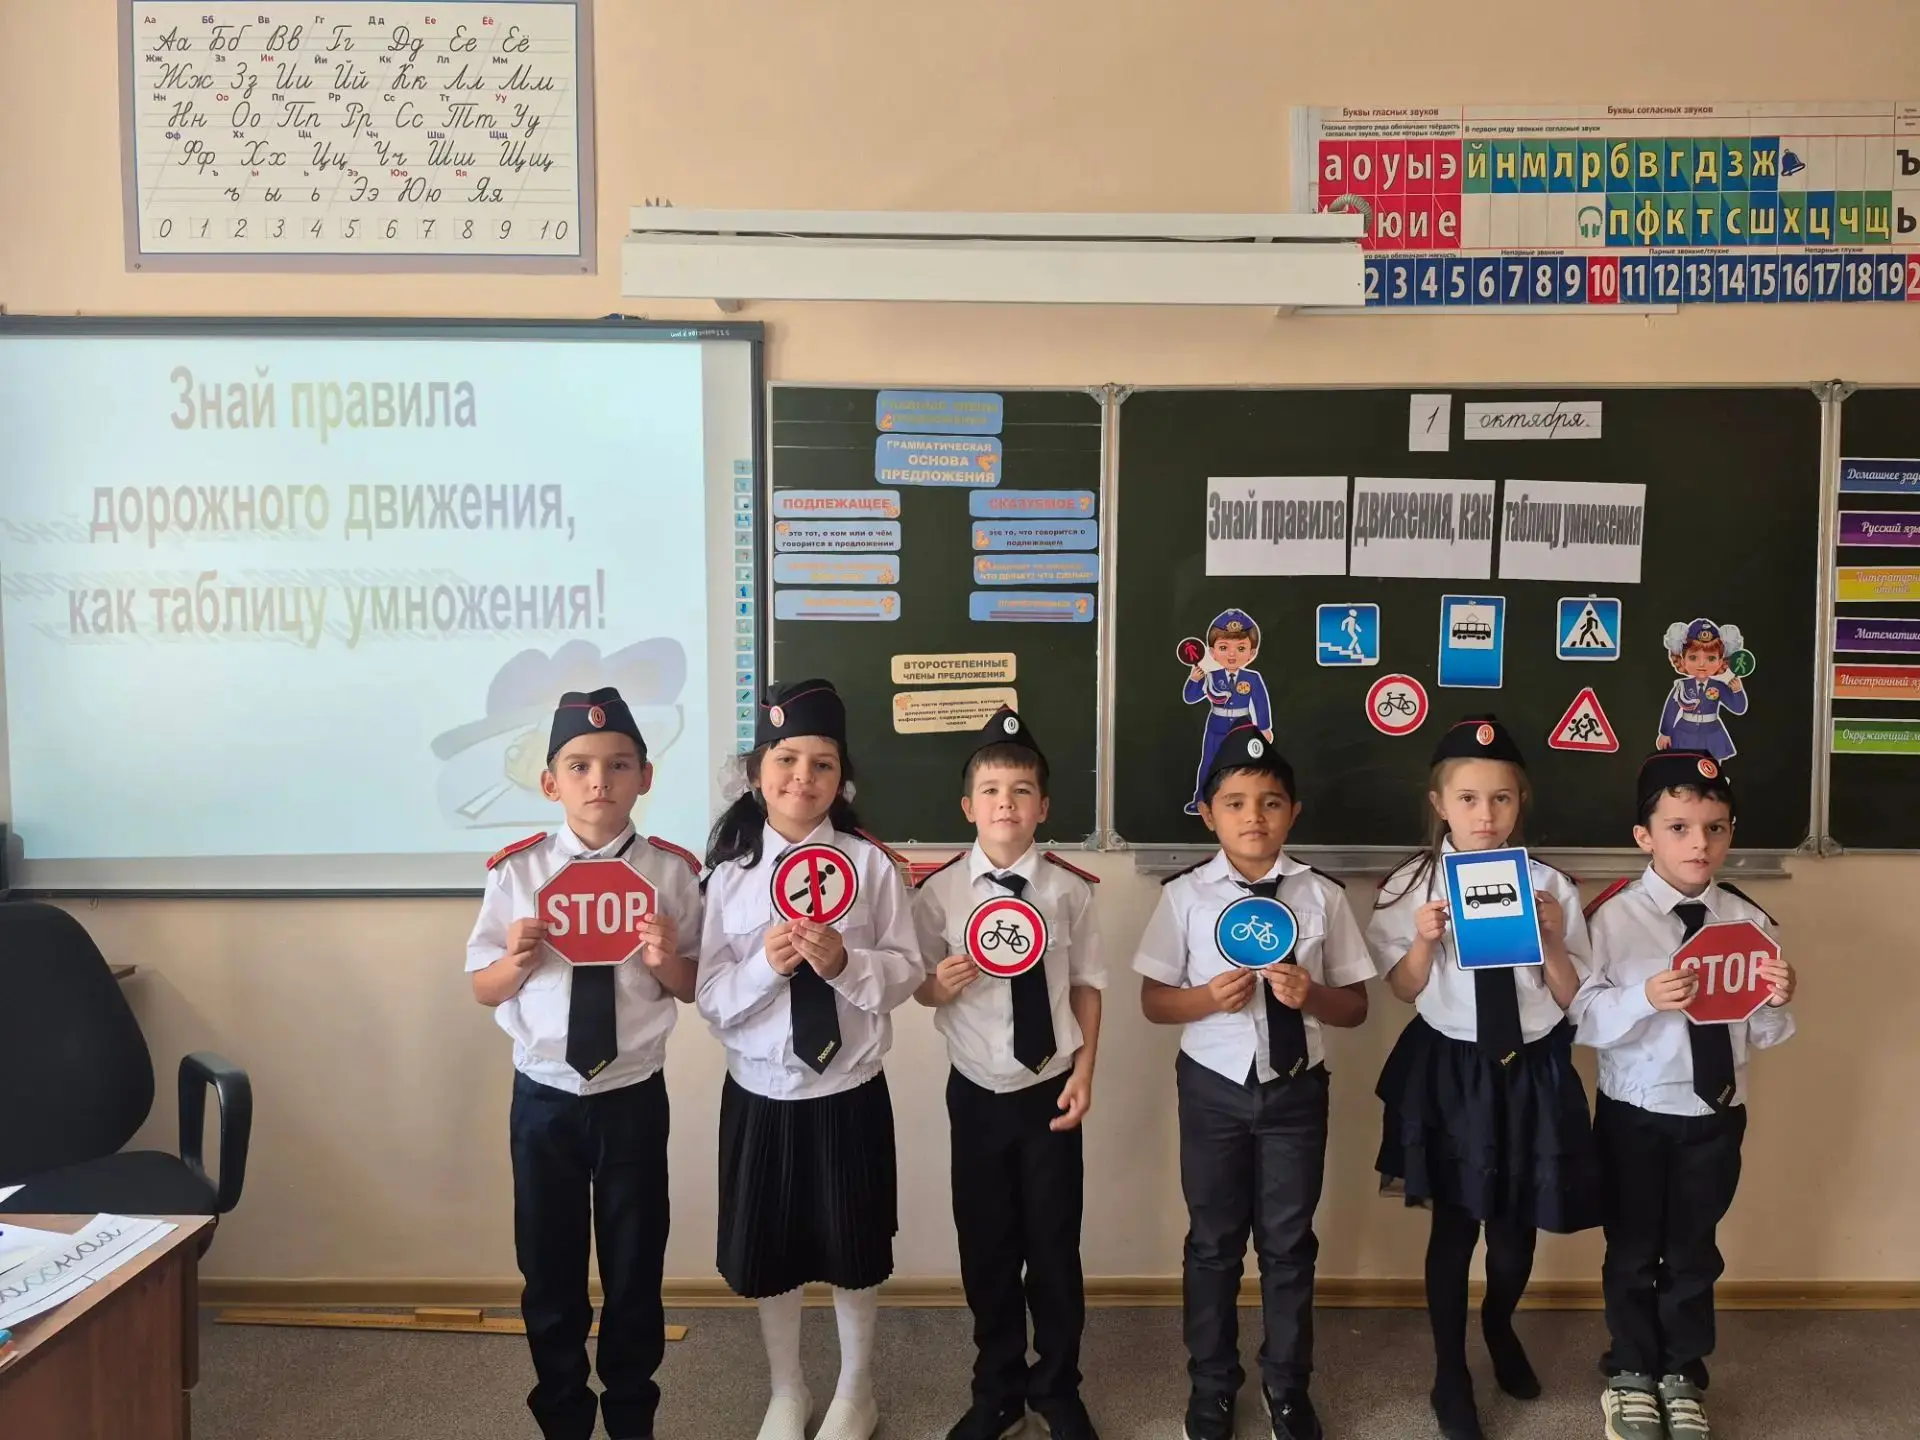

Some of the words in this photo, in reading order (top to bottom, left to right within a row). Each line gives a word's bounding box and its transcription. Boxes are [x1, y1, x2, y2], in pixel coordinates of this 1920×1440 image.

[153, 26, 192, 51] Аа
[209, 25, 253, 51] Бб
[266, 25, 303, 51] Вв
[326, 25, 355, 51] Гг
[387, 25, 425, 62] Дд
[449, 25, 478, 52] Ее
[153, 63, 214, 89] Жж
[230, 62, 258, 100] Зз
[275, 62, 313, 90] Ии
[334, 60, 370, 90] Йй
[391, 63, 428, 90] Кк
[443, 63, 485, 90] Лл
[498, 64, 555, 91] Мм
[168, 101, 208, 128] Нн
[231, 101, 261, 128] Оо
[276, 101, 321, 128] Пп
[341, 102, 373, 138] Рр
[395, 101, 424, 128] Сс
[441, 103, 497, 129] Тт
[510, 103, 541, 138] Уу
[1343, 108, 1370, 118] Буквы
[1372, 108, 1408, 116] гласных
[1410, 108, 1439, 117] звуков
[1607, 105, 1635, 115] Буквы
[1637, 105, 1682, 115] согласных
[1683, 105, 1714, 115] звуков
[178, 140, 216, 176] Фф
[240, 140, 287, 166] Хх
[312, 141, 348, 171] Цц
[374, 140, 407, 166] Чч
[427, 140, 476, 166] Шш
[499, 140, 554, 173] Щщ
[349, 176, 379, 202] Ээ
[398, 176, 442, 203] Юю
[467, 176, 504, 203] Яя
[159, 218, 173, 238] 0
[200, 218, 210, 238] 1
[234, 218, 248, 238] 2
[272, 218, 285, 239] 3
[310, 218, 323, 239] 4
[344, 218, 360, 239] 5
[386, 219, 399, 239] 6
[422, 219, 437, 240] 7
[462, 219, 474, 240] 8
[500, 219, 512, 240] 9
[540, 219, 569, 241] 10
[1365, 267, 1380, 299] 2
[1392, 266, 1408, 299] 3
[1420, 266, 1438, 299] 4
[1450, 266, 1465, 299] 5
[1478, 265, 1495, 298] 6
[1507, 265, 1524, 298] 7
[1535, 265, 1552, 298] 8
[1564, 264, 1581, 297] 9
[1590, 264, 1616, 297] 10
[1622, 264, 1646, 296] 11
[1654, 264, 1680, 296] 12
[1686, 264, 1712, 296] 13
[1717, 263, 1745, 296] 14
[1750, 263, 1776, 296] 15
[1782, 263, 1809, 296] 16
[1814, 262, 1841, 296] 17
[1846, 262, 1872, 295] 18
[1877, 262, 1905, 295] 19
[170, 366, 274, 429] Знай
[291, 380, 477, 443] правила
[1426, 406, 1439, 434] 1
[1480, 401, 1591, 439] октября.
[886, 440, 993, 452] ГРАММАТИЧЕСКАЯ
[908, 454, 969, 466] ОСНОВА
[881, 469, 995, 483] ПРЕДЛОЖЕНИЯ
[1846, 467, 1900, 481] Домашнее
[90, 484, 330, 547] дорожного
[344, 483, 577, 541] движения,
[783, 498, 892, 511] ПОДЛЕЖАЩЕЕ
[1208, 489, 1258, 540] Знай
[1261, 499, 1345, 545] правила
[1354, 491, 1455, 547] движения,
[1458, 492, 1493, 541] как
[1504, 493, 1563, 550] таблицу
[1562, 502, 1642, 549] умножения
[805, 530, 821, 538] тот,
[875, 529, 893, 537] чём
[1861, 521, 1902, 537] Русский
[782, 541, 826, 549] говорится
[835, 541, 895, 549] предложении
[69, 588, 136, 636] как
[151, 570, 326, 650] таблицу
[345, 569, 607, 650] умножения!
[903, 659, 1009, 670] ВТОРОСТЕПЕННЫЕ
[903, 672, 936, 681] ЧЛЕНЫ
[937, 671, 1006, 680] ПРЕДЛОЖЕНИЯ
[1840, 674, 1909, 690] Иностранный
[1842, 728, 1909, 743] Окружающий
[547, 891, 648, 937] STOP
